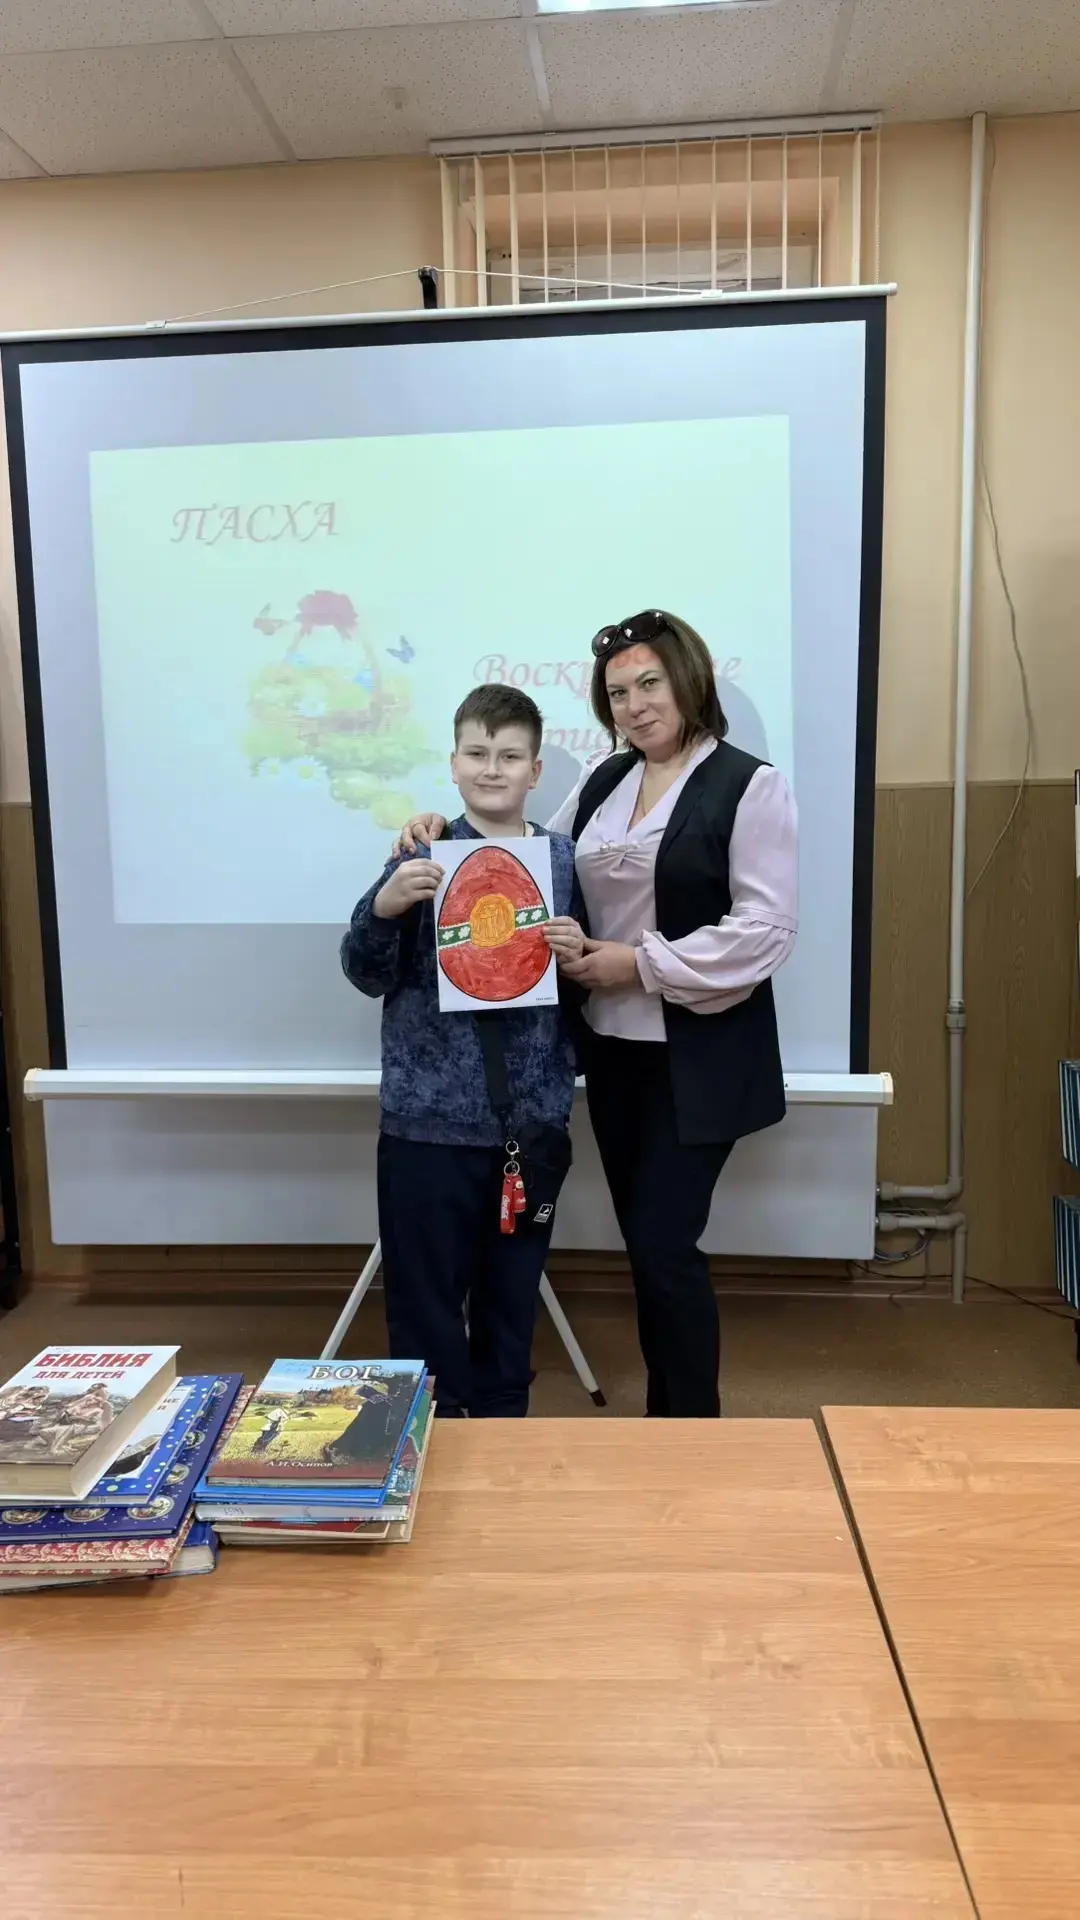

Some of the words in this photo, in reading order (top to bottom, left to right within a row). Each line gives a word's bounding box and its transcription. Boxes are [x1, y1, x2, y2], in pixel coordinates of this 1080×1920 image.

[170, 500, 338, 546] ПАСХА
[34, 1353, 154, 1368] БИБЛИЯ
[32, 1371, 70, 1380] ДЛЯ
[68, 1370, 126, 1380] ДЕТЕЙ
[308, 1364, 382, 1381] БОГ
